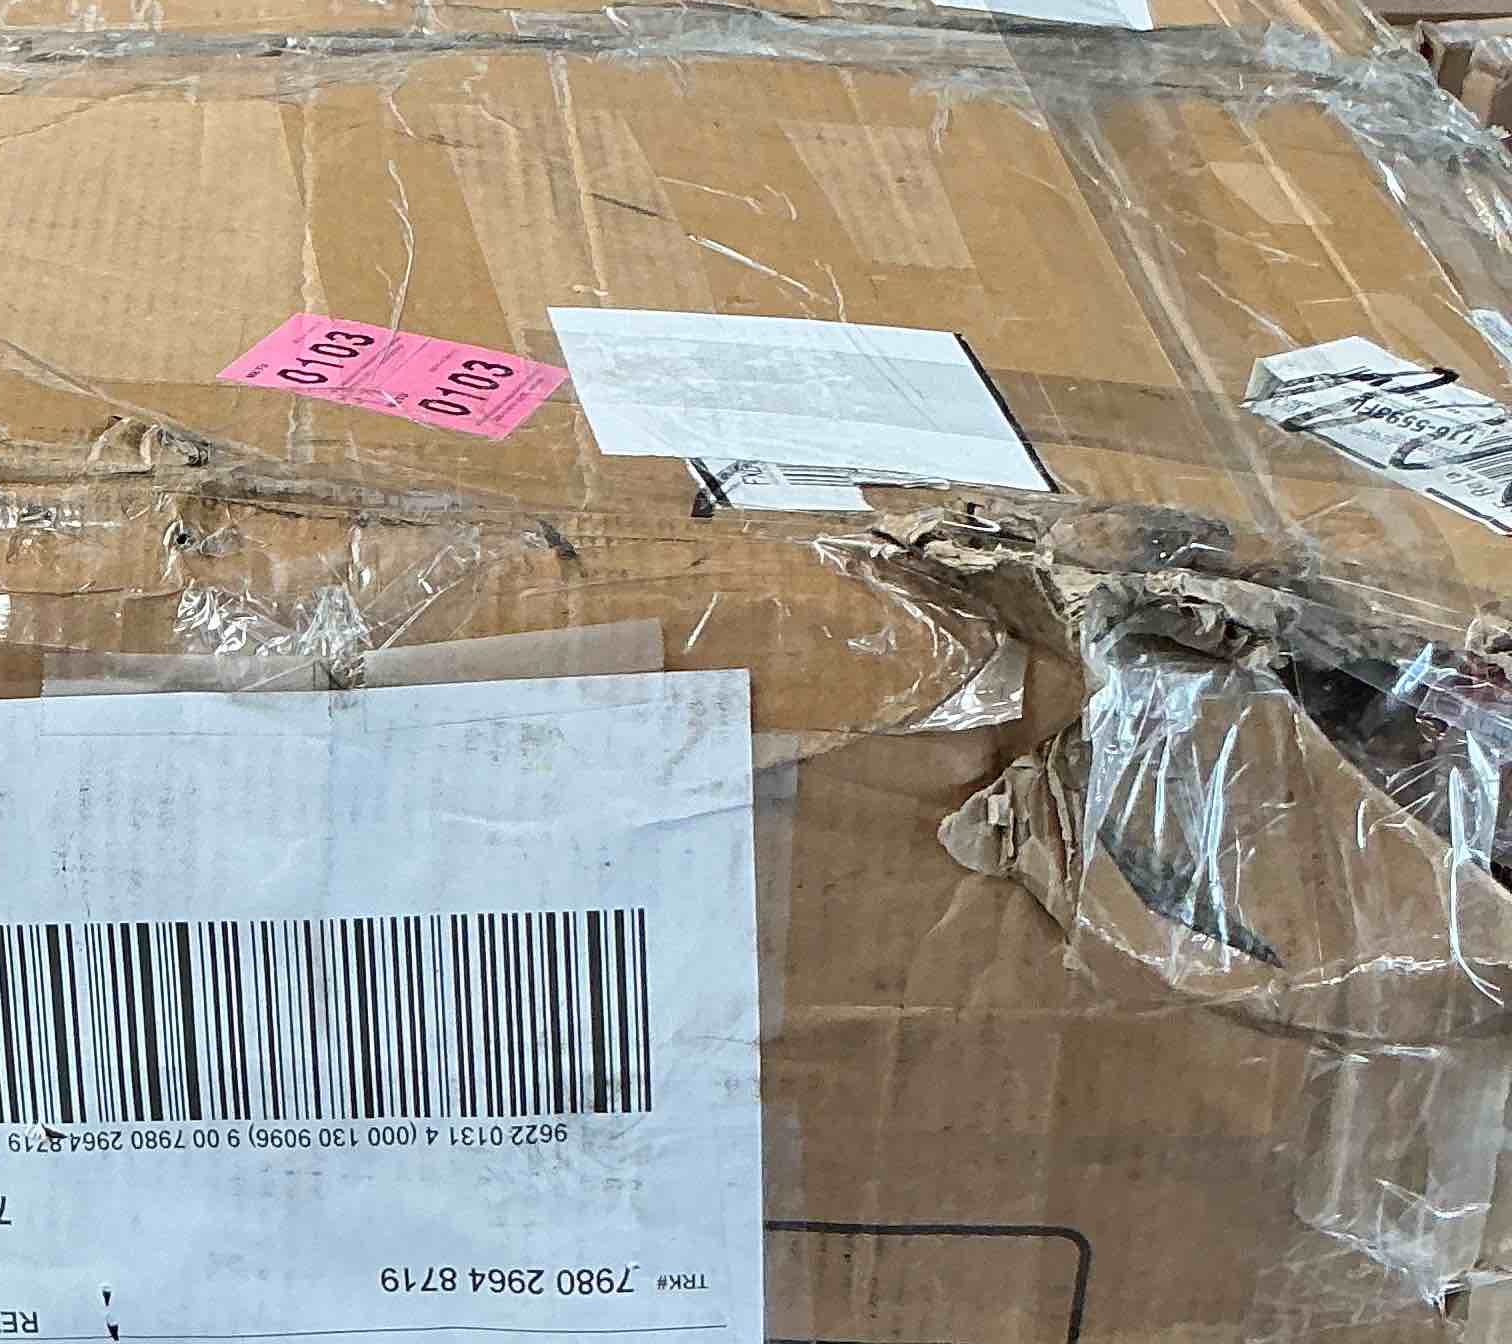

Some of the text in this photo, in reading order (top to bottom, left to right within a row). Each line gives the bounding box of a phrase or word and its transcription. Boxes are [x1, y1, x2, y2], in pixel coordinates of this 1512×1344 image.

[277, 330, 376, 385] 0103
[418, 359, 514, 417] 0103
[69, 1131, 123, 1152] 2964
[131, 1130, 185, 1150] 7980
[192, 1129, 219, 1148] 00
[227, 1129, 241, 1148] 9
[249, 1124, 311, 1148] 9096)
[318, 1128, 359, 1148] 130
[367, 1122, 417, 1147] (000
[425, 1127, 439, 1146] 4
[449, 1126, 503, 1146] 0131
[511, 1124, 568, 1146] 9622
[380, 1267, 709, 1295] TRK# 7980 2964 8719
